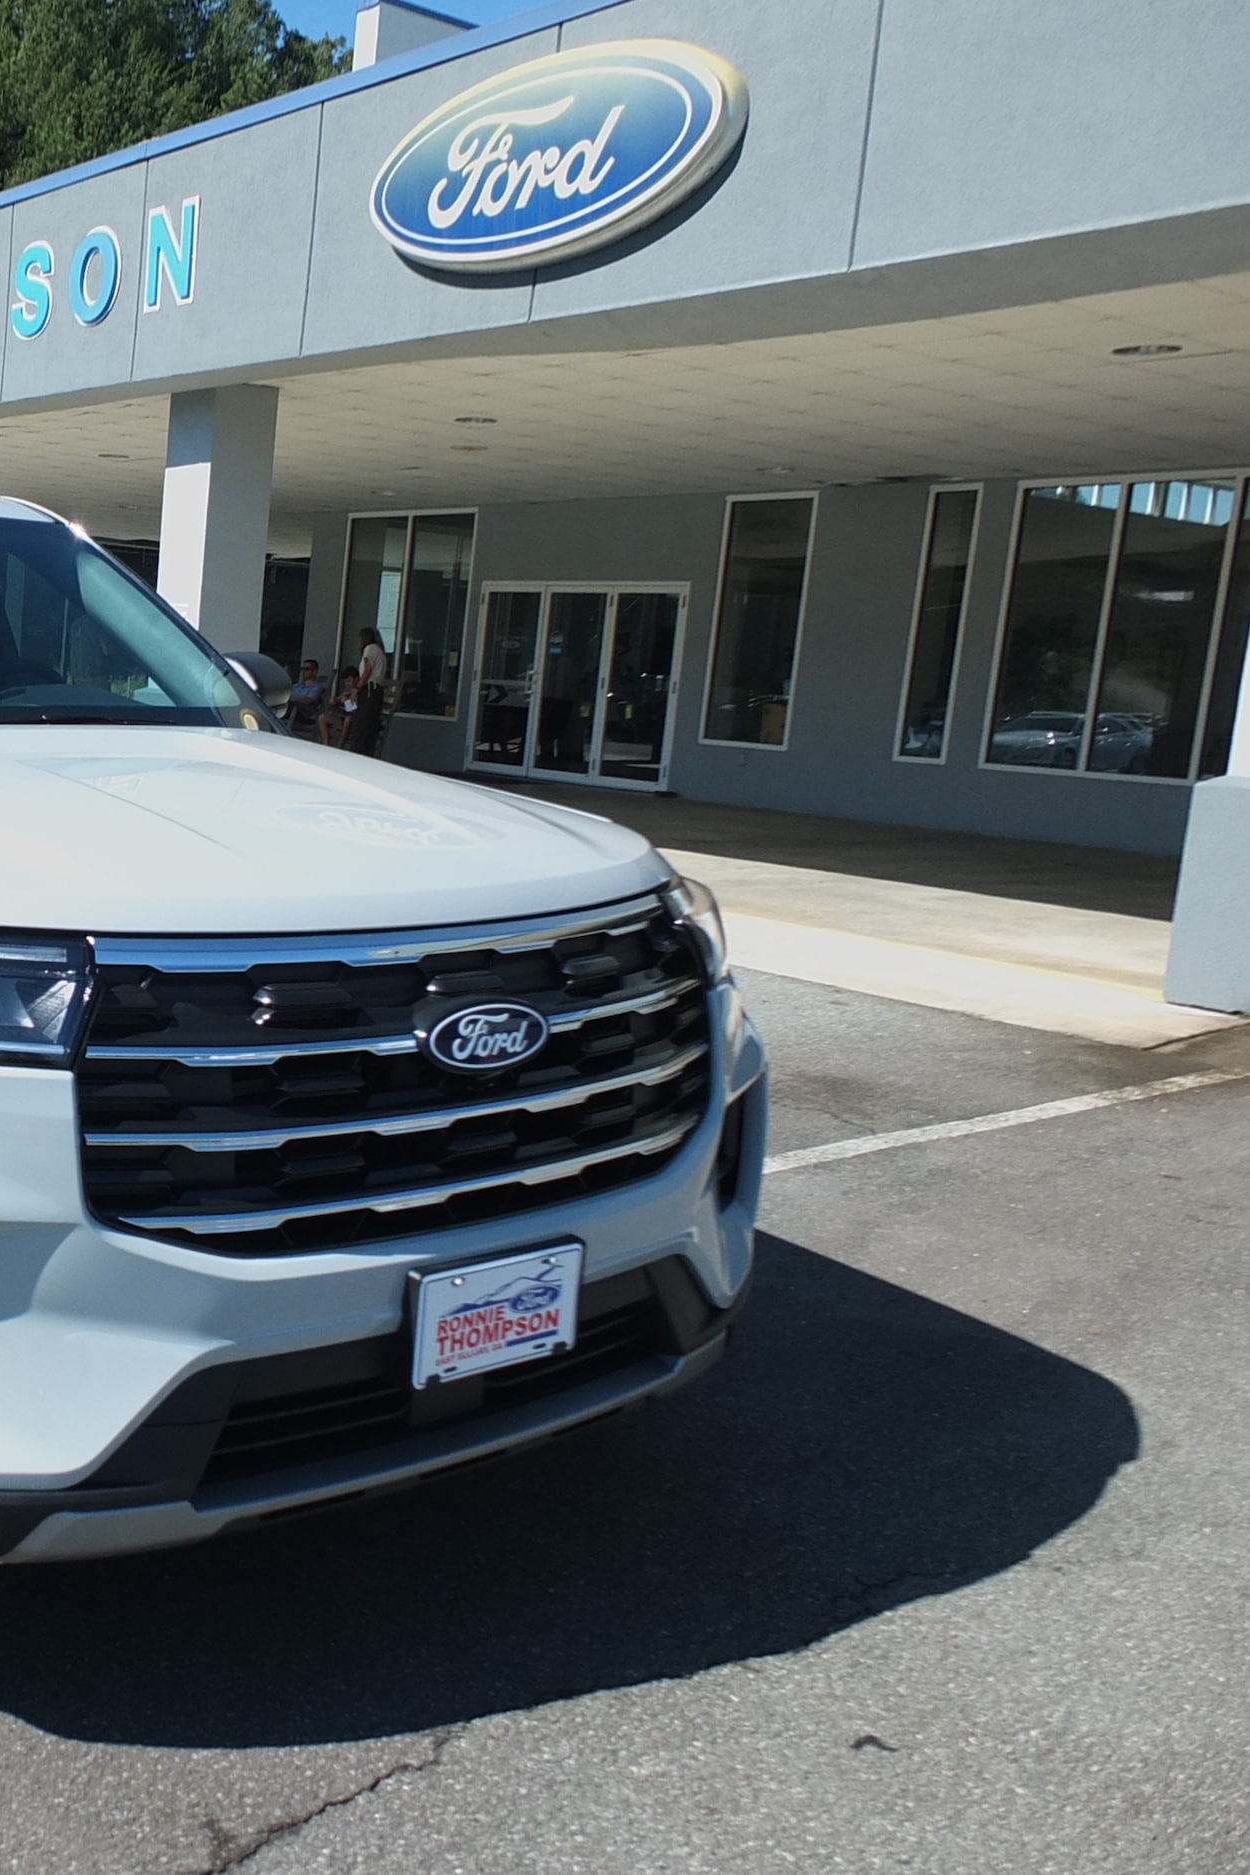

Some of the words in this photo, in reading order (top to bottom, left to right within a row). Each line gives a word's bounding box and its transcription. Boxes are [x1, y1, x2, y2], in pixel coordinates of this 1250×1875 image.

[427, 95, 625, 229] Ford
[452, 1013, 529, 1060] Ford
[436, 1308, 560, 1356] THOMPSON
[437, 1306, 505, 1337] RONNIE
